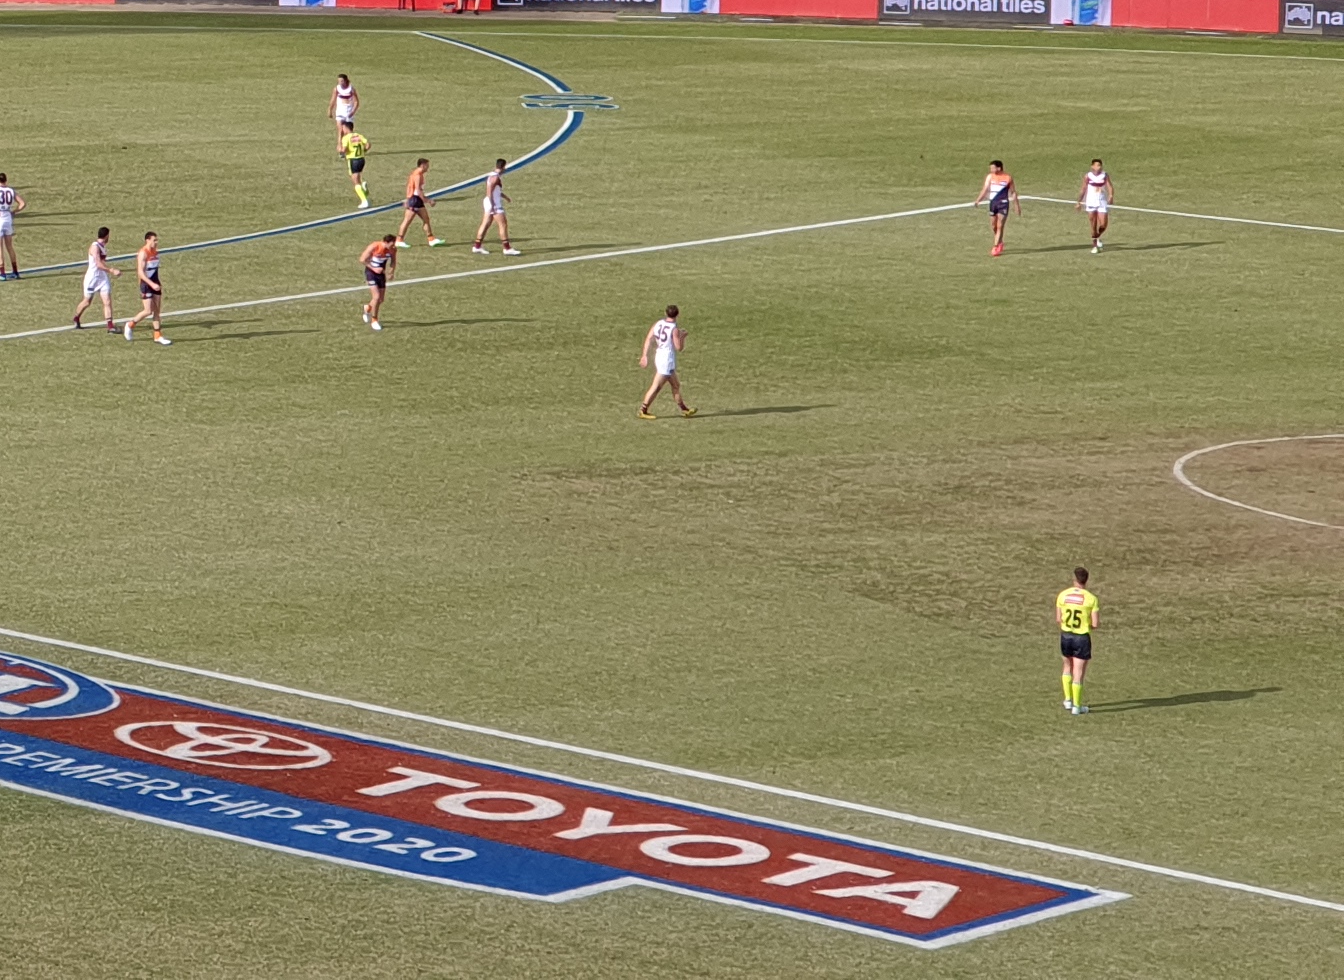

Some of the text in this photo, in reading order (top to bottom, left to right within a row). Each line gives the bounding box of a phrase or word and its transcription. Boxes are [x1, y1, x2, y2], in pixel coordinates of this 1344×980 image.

[1065, 609, 1083, 630] 25
[291, 818, 478, 863] 2020
[355, 766, 960, 920] TOYOTA
